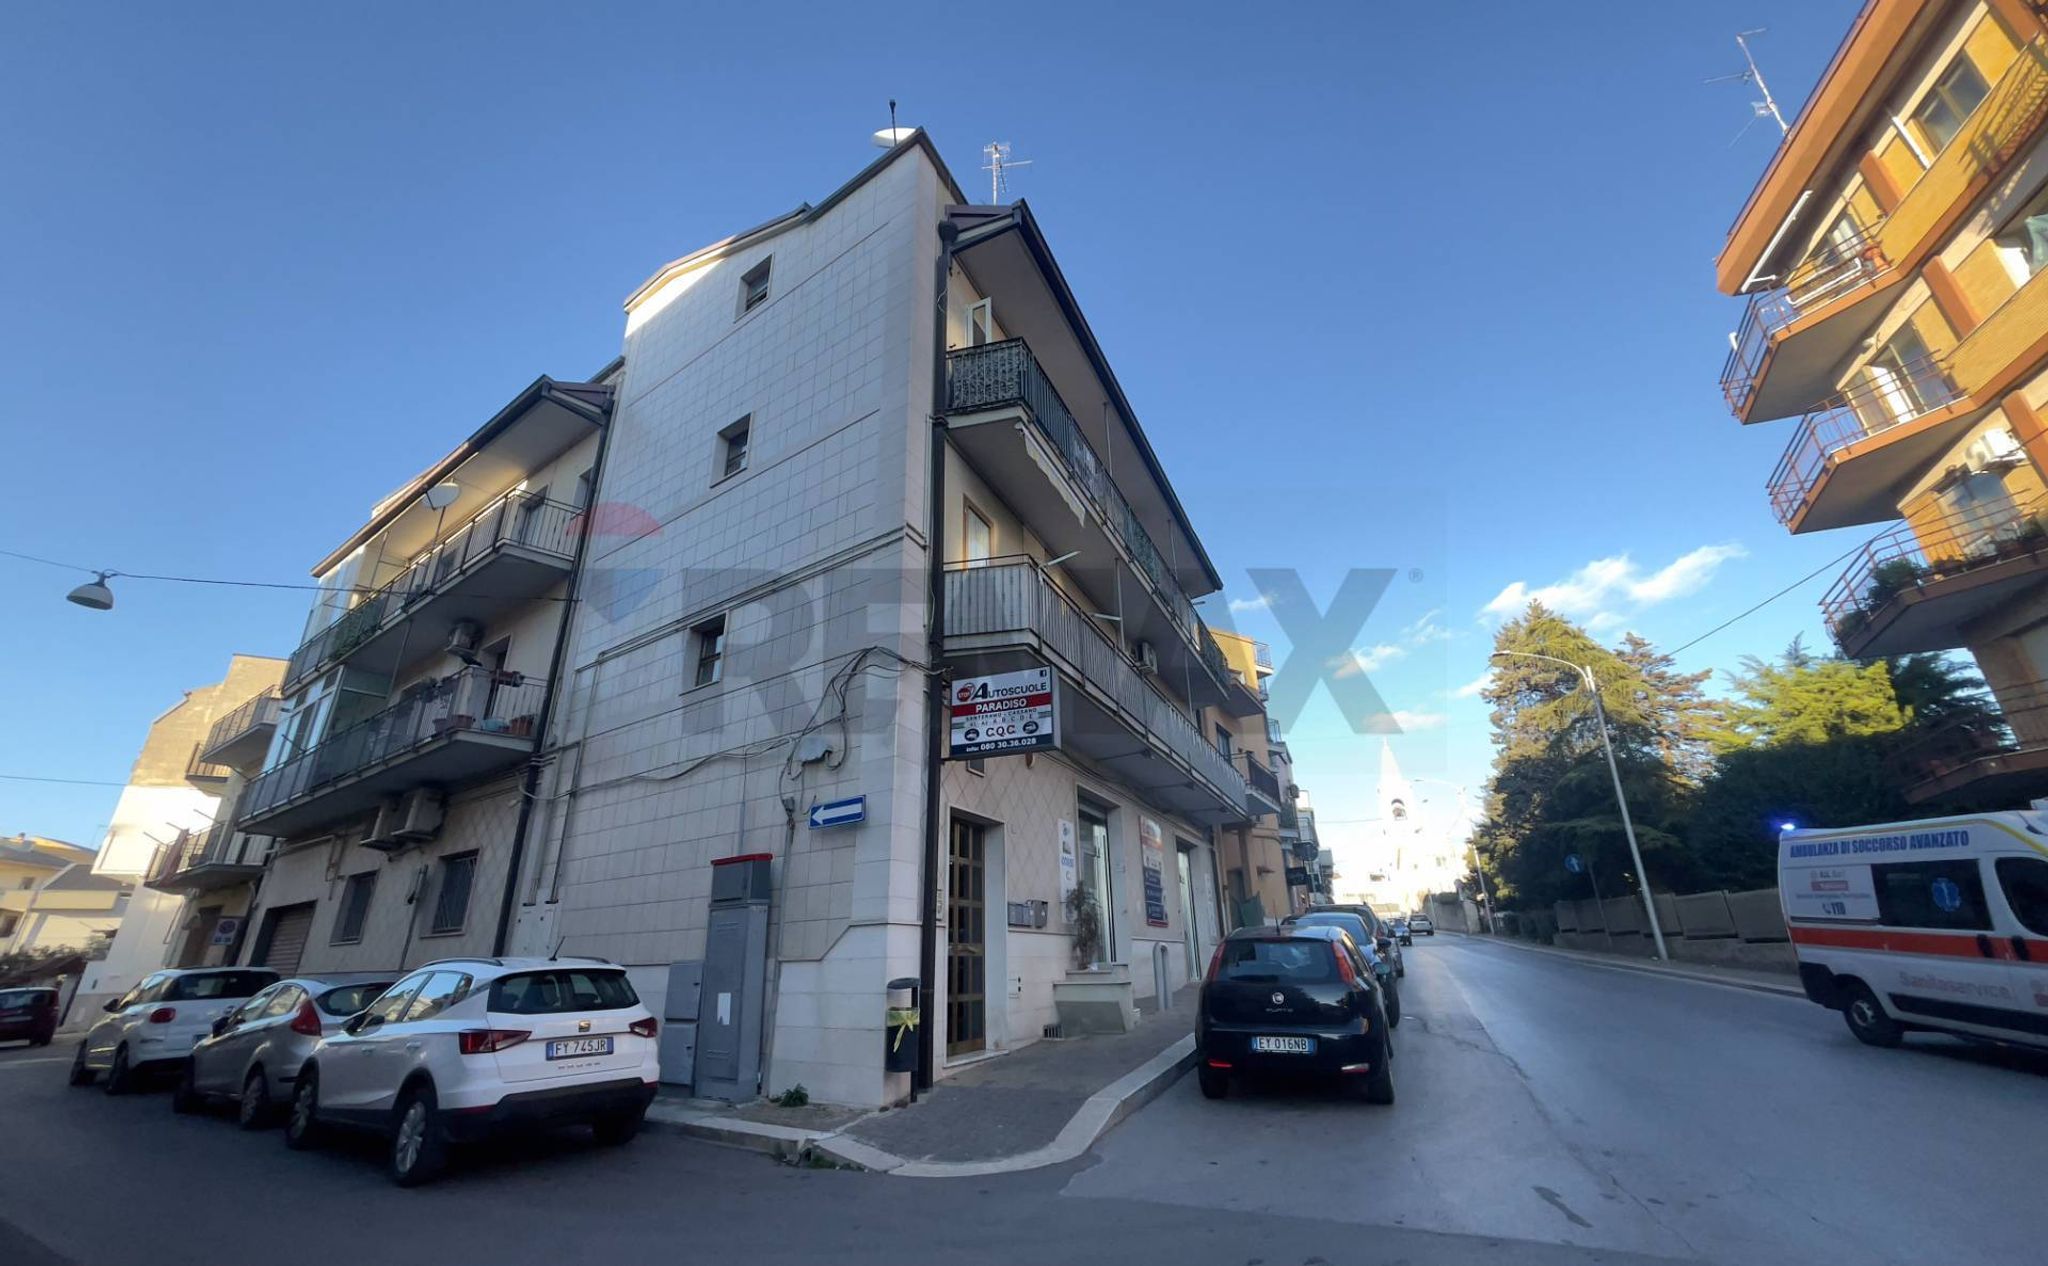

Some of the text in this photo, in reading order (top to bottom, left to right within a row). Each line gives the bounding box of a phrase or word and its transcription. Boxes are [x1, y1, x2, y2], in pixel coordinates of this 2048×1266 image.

[971, 682, 1047, 700] AUTOSCUOLE
[975, 698, 1027, 713] PARADISO
[1790, 830, 1970, 858] AMBULANZA DI SOCCORSO AVANZATO
[555, 1039, 606, 1055] FY 745JR
[1259, 1037, 1307, 1050] EY 016NB
